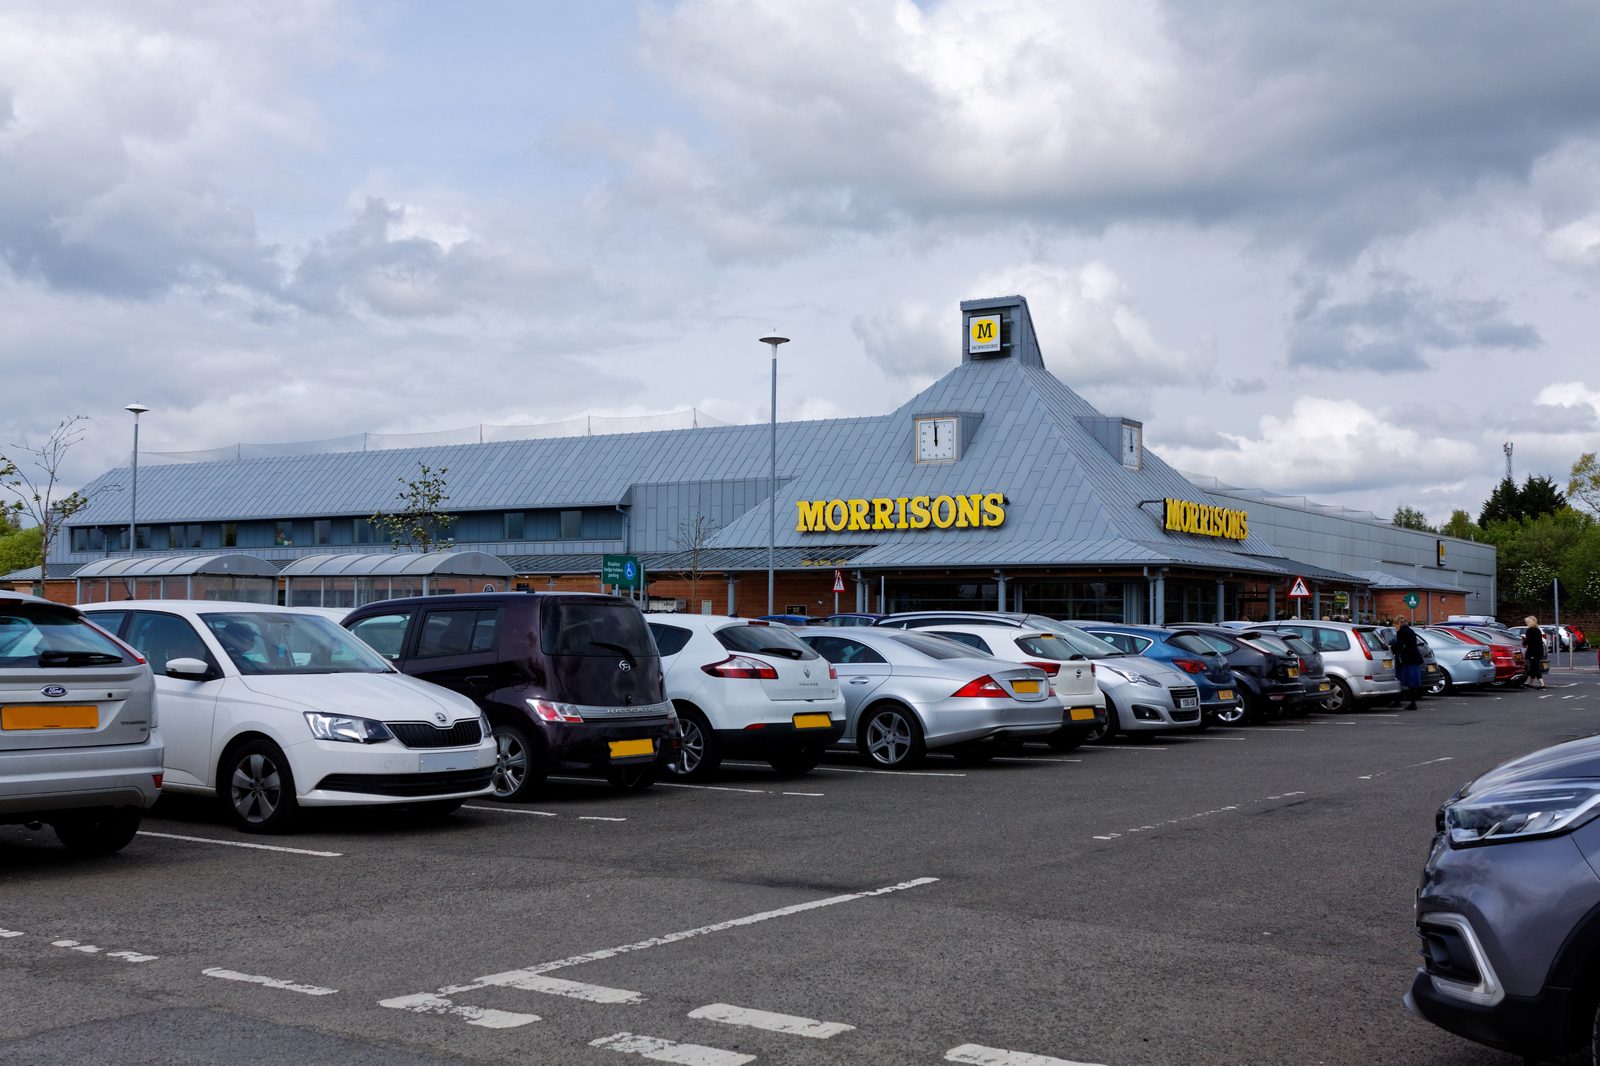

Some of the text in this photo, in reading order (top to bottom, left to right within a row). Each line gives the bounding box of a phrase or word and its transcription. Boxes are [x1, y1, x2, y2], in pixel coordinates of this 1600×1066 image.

[977, 323, 992, 339] M
[796, 493, 1005, 531] MORRISONS
[1165, 498, 1248, 540] MORRISONS
